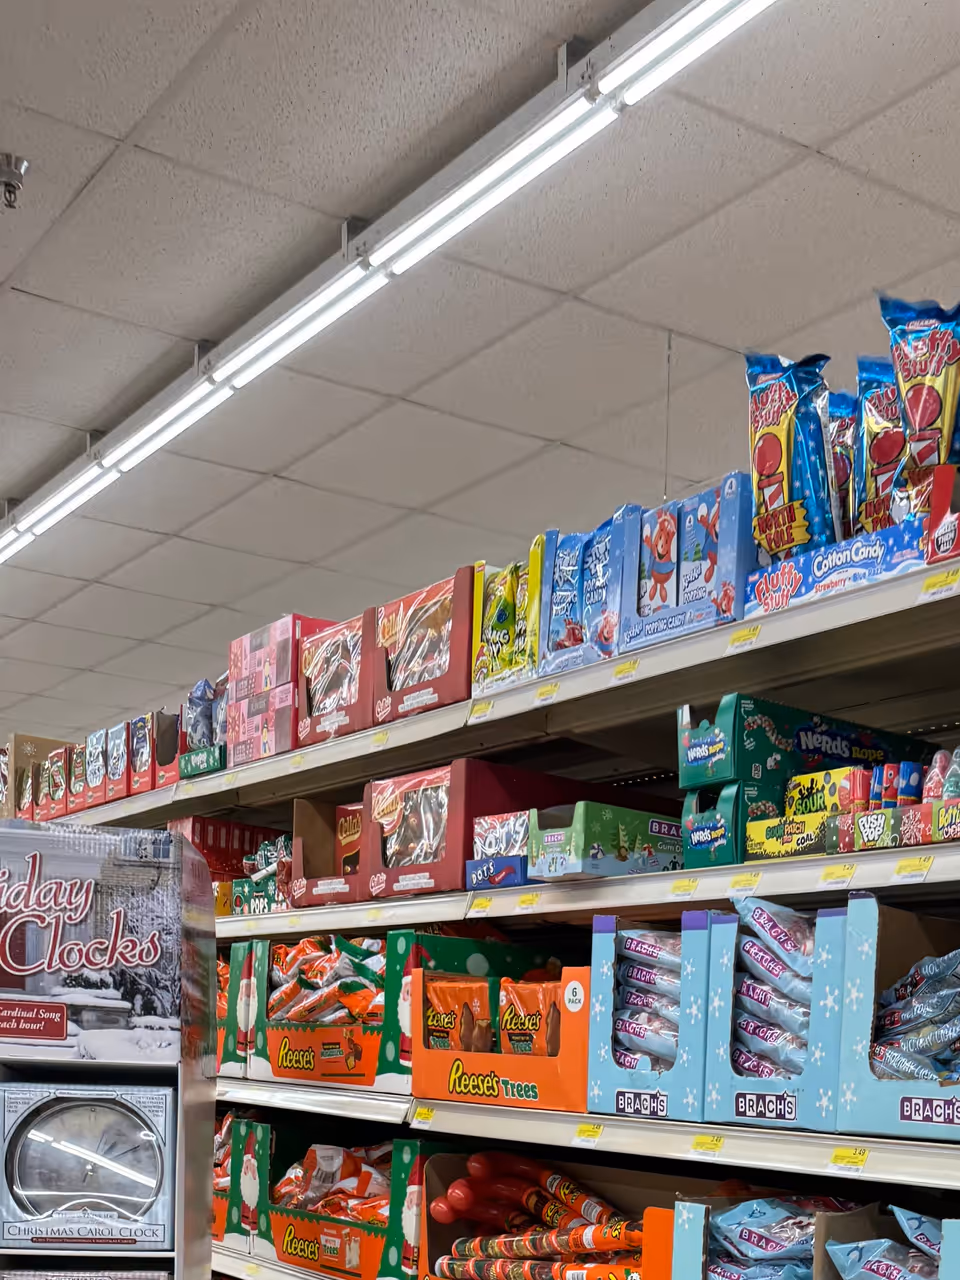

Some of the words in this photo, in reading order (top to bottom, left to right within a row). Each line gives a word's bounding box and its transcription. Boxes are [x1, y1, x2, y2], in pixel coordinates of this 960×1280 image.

[757, 504, 796, 534] NORTH
[764, 527, 796, 552] POLE
[813, 545, 852, 578] Cotton
[849, 539, 886, 565] Candy
[755, 563, 803, 600] Fluffy
[814, 576, 848, 594] Strawberry
[762, 589, 790, 614] Stuff
[644, 616, 668, 635] POPPING
[795, 795, 827, 816] SOUR
[857, 813, 887, 831] PUSH
[796, 834, 816, 848] COAL
[860, 827, 882, 843] POP
[658, 841, 675, 853] Gum
[471, 860, 495, 885] DOTS
[250, 897, 269, 914] POPS
[0, 907, 161, 975] Clocks
[572, 987, 578, 997] 6
[19, 1020, 45, 1031] hour!
[38, 1009, 61, 1022] Song
[501, 1004, 541, 1031] Reese's
[277, 1037, 316, 1072] Reese's
[448, 1058, 500, 1097] Reese's
[501, 1078, 539, 1100] Trees
[852, 1148, 867, 1157] 3.49
[77, 1226, 117, 1238] CAROL
[119, 1227, 160, 1238] CLOCK
[282, 1225, 320, 1262] Reese's
